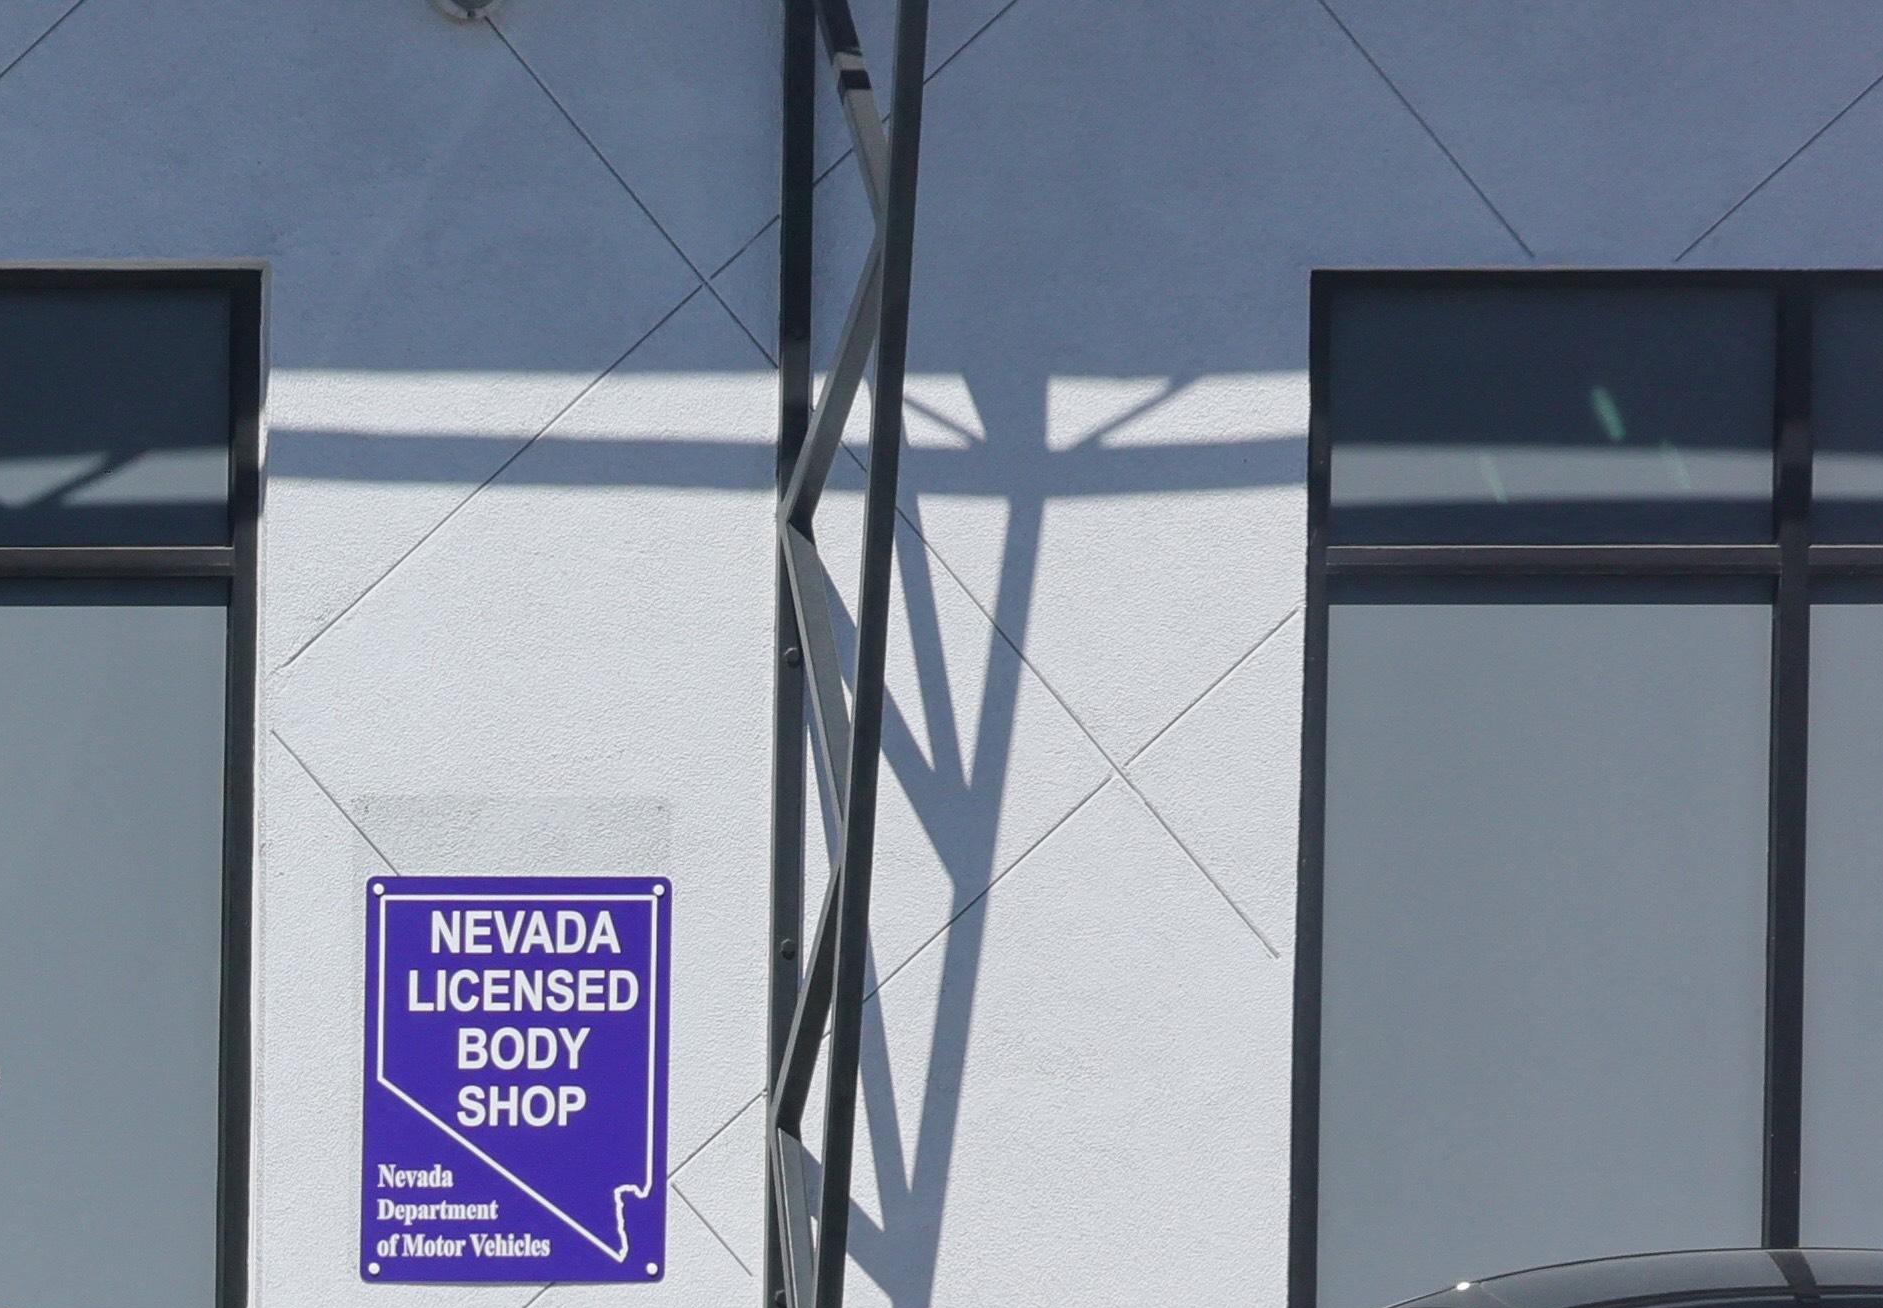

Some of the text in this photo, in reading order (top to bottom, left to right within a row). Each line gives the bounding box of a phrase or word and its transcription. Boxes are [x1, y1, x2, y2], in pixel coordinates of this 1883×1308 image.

[431, 910, 621, 953] NEVADA
[408, 969, 638, 1011] LICENSED
[457, 1027, 590, 1069] BODY
[456, 1085, 586, 1127] SHOP
[377, 1164, 453, 1188] Nevada
[377, 1199, 498, 1226] Department
[377, 1233, 550, 1257] of Motor Vehicles
